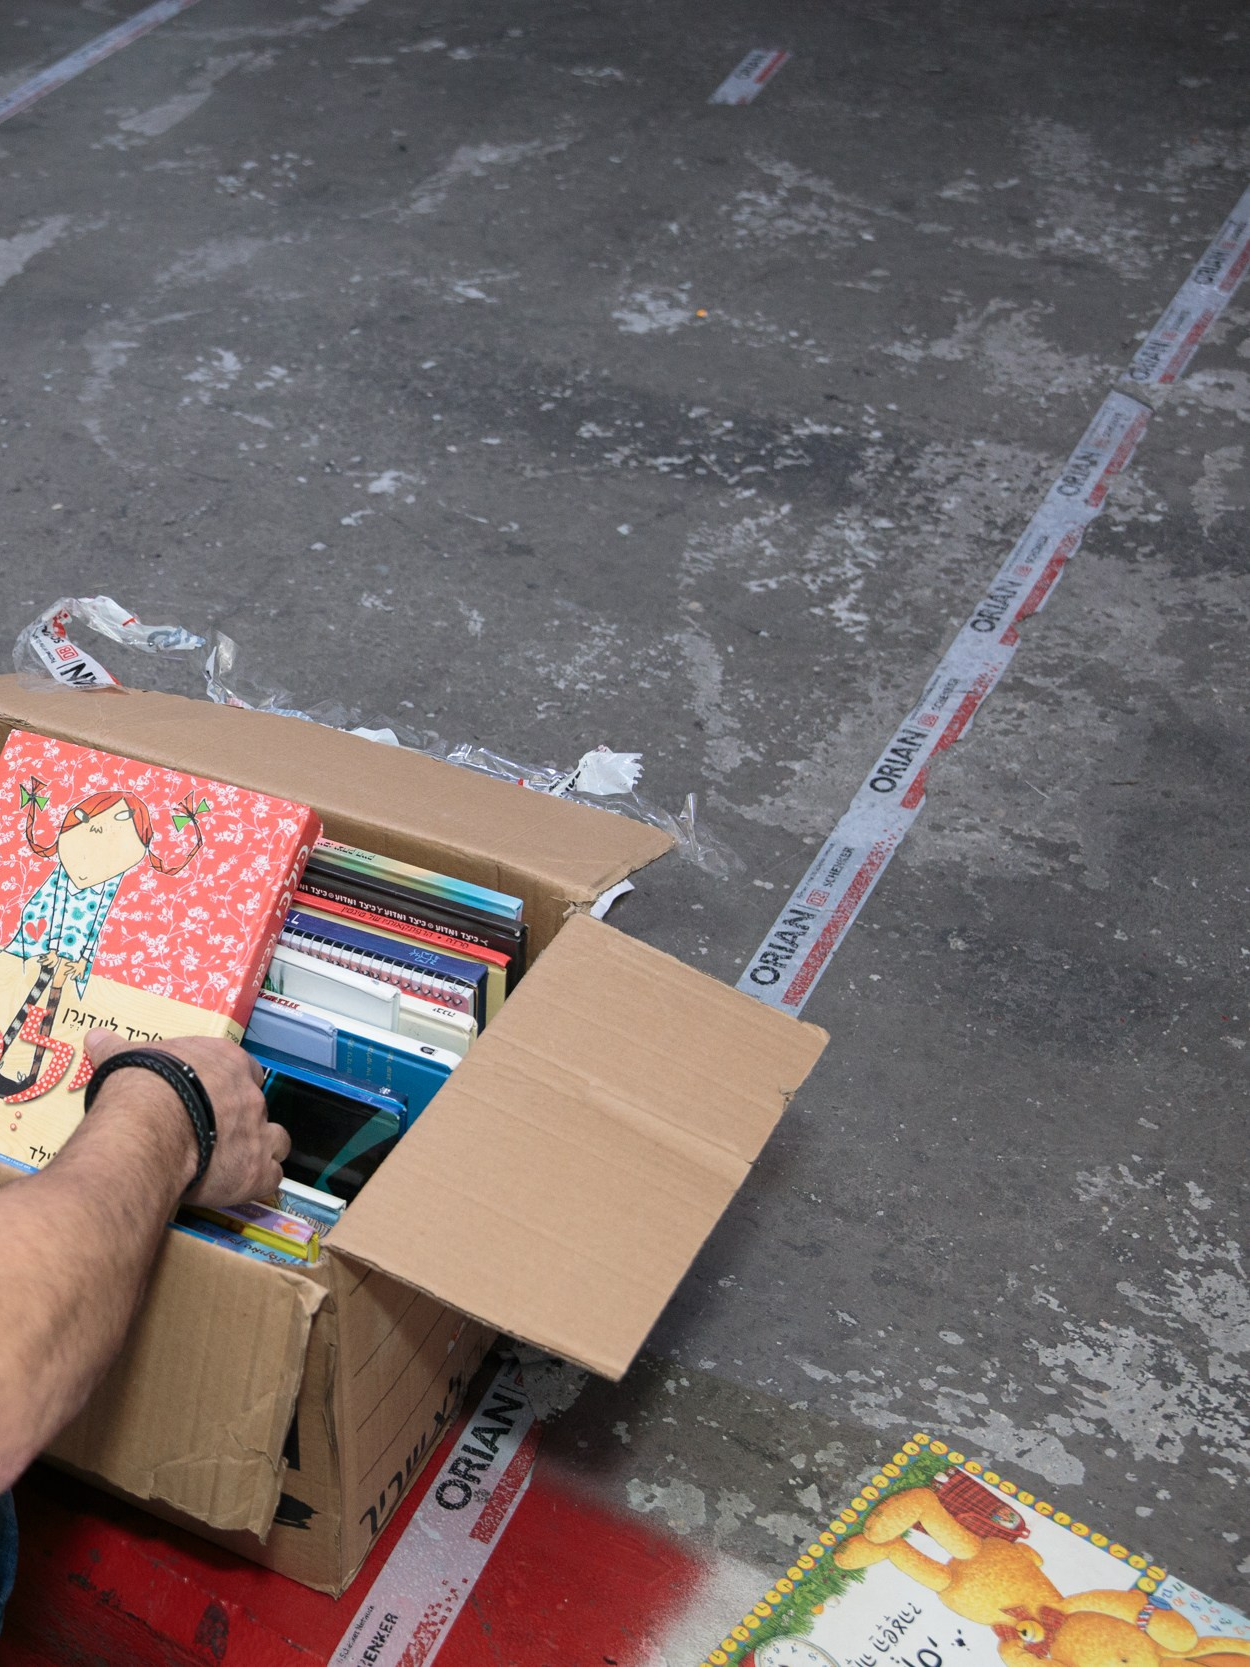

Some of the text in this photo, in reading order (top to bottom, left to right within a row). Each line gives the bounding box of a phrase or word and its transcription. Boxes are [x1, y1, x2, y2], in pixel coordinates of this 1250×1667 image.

[969, 578, 1022, 634] ORIAN
[55, 644, 78, 661] DB
[869, 727, 929, 794] ORIAN
[333, 893, 356, 906] ומדוע
[357, 900, 376, 912] כיצד
[383, 908, 406, 921] ומדוע
[407, 916, 426, 927] כיצד
[434, 924, 458, 937] ומדוע
[459, 932, 478, 943] כיצד
[750, 908, 818, 987] ORIAN
[431, 1006, 456, 1018] יבנה
[435, 1393, 525, 1512] ORIAN
